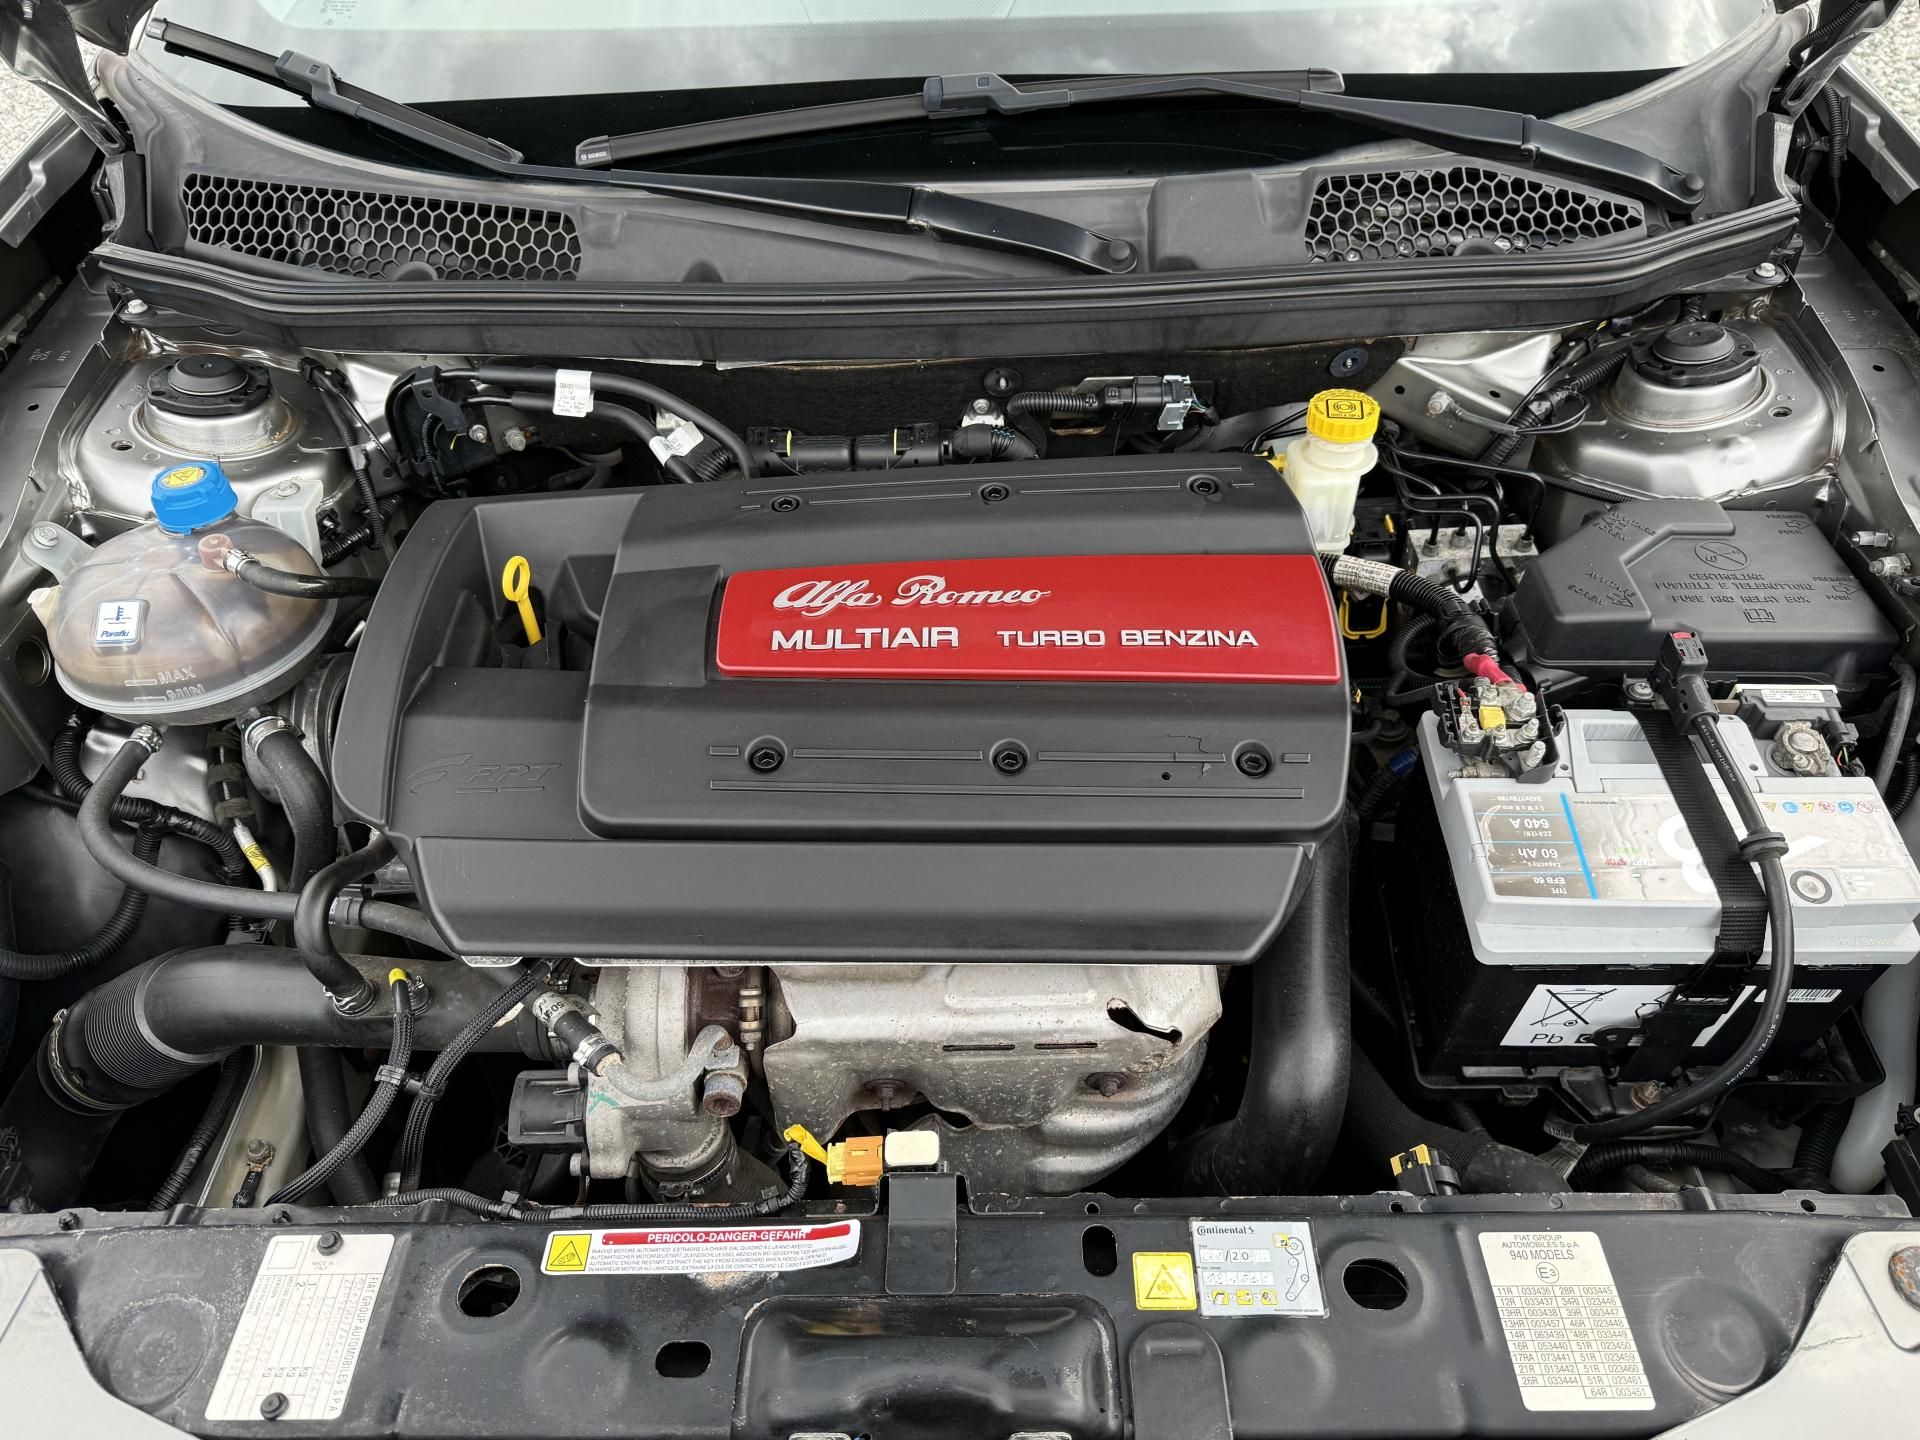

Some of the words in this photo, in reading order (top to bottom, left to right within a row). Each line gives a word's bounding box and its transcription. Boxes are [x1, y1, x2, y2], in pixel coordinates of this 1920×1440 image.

[773, 581, 882, 616] Alfa
[891, 576, 1052, 606] Romeo
[101, 630, 129, 638] Paraflu
[772, 627, 960, 651] MULTIAIR
[997, 630, 1105, 647] TURBO
[1121, 630, 1258, 648] BENZINA
[158, 666, 196, 684] MAX
[166, 684, 205, 702] MIN
[1509, 819, 1520, 828] A
[1524, 819, 1549, 828] 640
[1518, 848, 1537, 858] Ah
[1541, 848, 1558, 858] 60
[1530, 1033, 1563, 1043] Pb
[1196, 1225, 1246, 1236] Continental
[647, 1231, 807, 1243] PERICOLO-DANGER-GEFAHR
[1510, 1250, 1529, 1260] 940
[1530, 1250, 1574, 1260] MODELS
[365, 1277, 379, 1293] FIAT
[1521, 1287, 1551, 1295] 033436
[1558, 1287, 1575, 1295] 28R
[1583, 1287, 1613, 1295] 003445
[1501, 1298, 1516, 1306] 12R
[1525, 1298, 1554, 1306] 033437
[1586, 1298, 1617, 1306] 023446
[357, 1296, 372, 1323] GROUP
[1500, 1309, 1522, 1317] 13HR
[1527, 1309, 1558, 1317] 003438
[1566, 1309, 1583, 1317] 39R
[1504, 1320, 1525, 1328] 13HR
[1530, 1320, 1560, 1328] 003457
[1569, 1320, 1586, 1328] 46R
[1509, 1331, 1526, 1339] 14R
[1534, 1331, 1566, 1339] 063439
[1573, 1331, 1590, 1339] 48R
[1596, 1330, 1628, 1338] 033449
[1537, 1342, 1569, 1350] 053440
[1576, 1342, 1594, 1350] 51R
[1600, 1342, 1632, 1350] 023450
[336, 1326, 363, 1384] AUTOMOBILES
[1513, 1354, 1534, 1362] 17RA
[1540, 1354, 1571, 1362] 073441
[1580, 1353, 1597, 1361] 51R
[1604, 1353, 1636, 1361] 023459
[274, 1367, 288, 1377] kg
[286, 1366, 299, 1377] kg
[298, 1366, 312, 1377] kg
[1518, 1365, 1536, 1373] 21R
[1544, 1365, 1576, 1373] 013442
[1583, 1365, 1601, 1373] 51R
[1607, 1364, 1639, 1373] 023460
[1521, 1377, 1539, 1385] 26R
[1548, 1376, 1579, 1385] 033444
[1587, 1377, 1604, 1385] 51R
[1612, 1376, 1643, 1385] 023461
[1590, 1388, 1608, 1396] 64R
[1615, 1388, 1647, 1396] 003451
